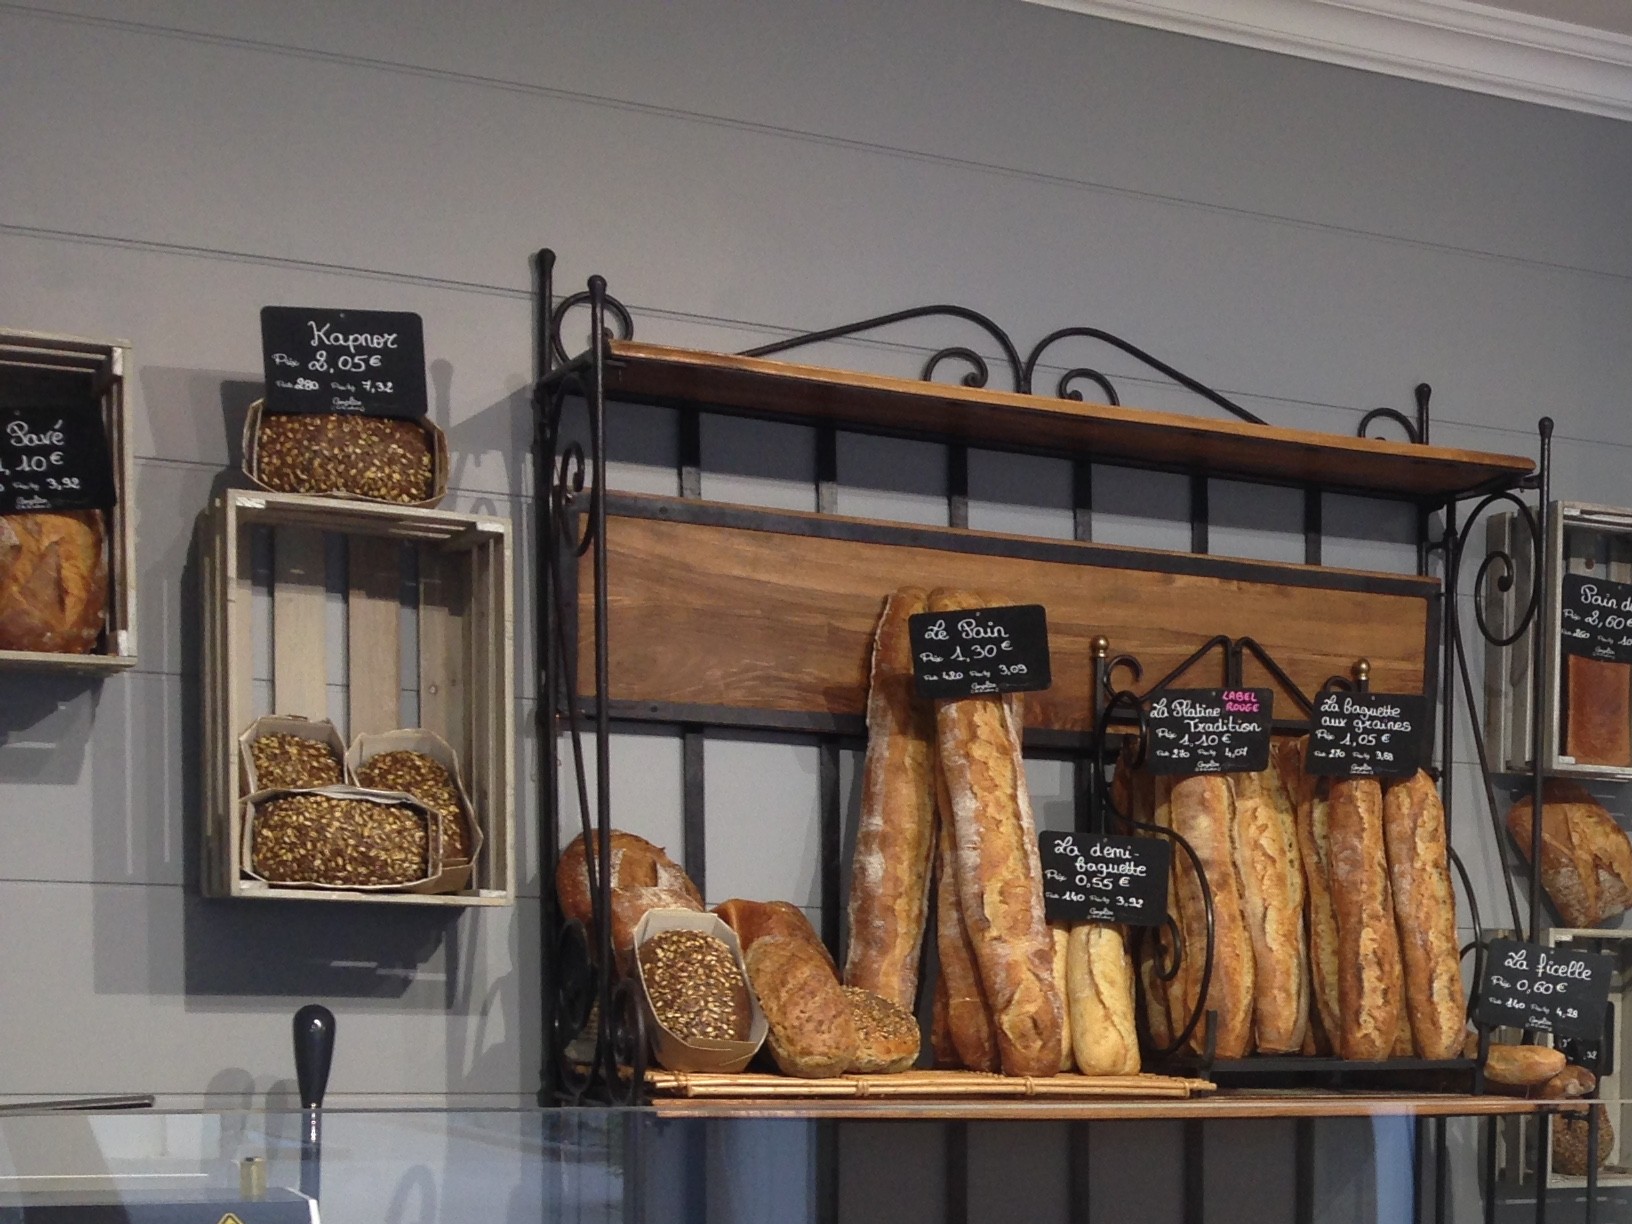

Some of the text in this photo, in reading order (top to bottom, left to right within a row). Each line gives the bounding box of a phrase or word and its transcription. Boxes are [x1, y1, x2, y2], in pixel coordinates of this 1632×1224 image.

[307, 320, 398, 353] Kapnor
[6, 419, 64, 447] Pavé
[1580, 584, 1617, 609] Pain
[924, 618, 1009, 640] Le Pain
[1222, 691, 1257, 702] LABEL
[1226, 702, 1259, 712] ROUGE
[1320, 694, 1400, 720] La baguette
[1150, 698, 1220, 718] La Platine
[1183, 716, 1262, 732] Tradition
[1321, 716, 1411, 733] aux graines
[1054, 836, 1081, 856] La
[1075, 856, 1146, 877] baguette
[1504, 949, 1592, 980] La ficelle
